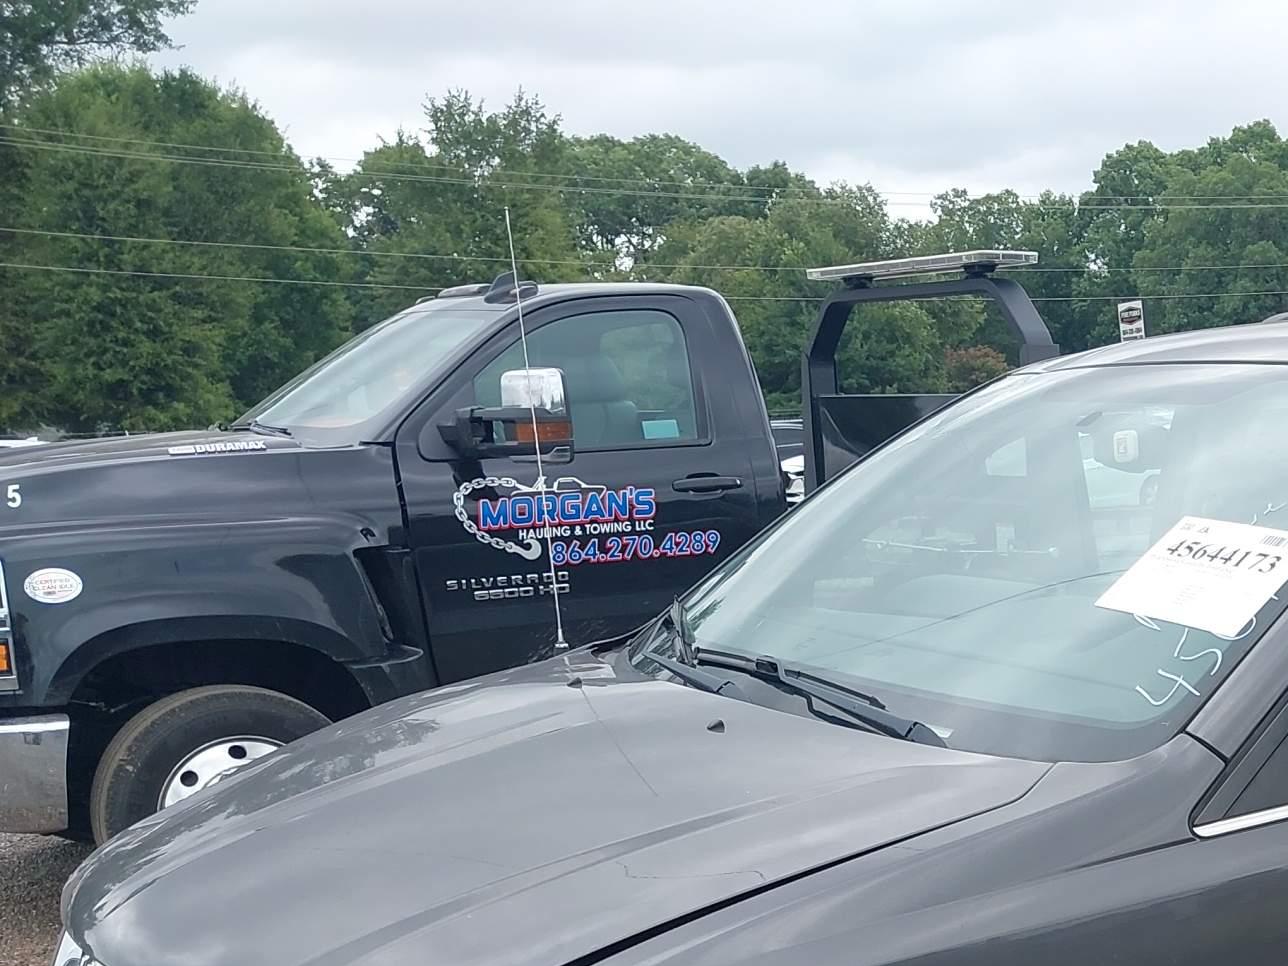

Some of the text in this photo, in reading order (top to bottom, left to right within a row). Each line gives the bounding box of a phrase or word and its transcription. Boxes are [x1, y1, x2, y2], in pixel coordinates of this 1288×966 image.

[195, 440, 267, 454] DURAMAX
[7, 484, 22, 508] 5
[479, 486, 656, 531] MORGAN'S
[574, 525, 582, 536] &
[585, 522, 632, 535] TOWING
[635, 520, 655, 532] LLC
[551, 530, 722, 566] 864.270.4289
[1165, 539, 1283, 574] 45644173
[446, 571, 569, 591] SILVERADO
[539, 583, 570, 595] HD
